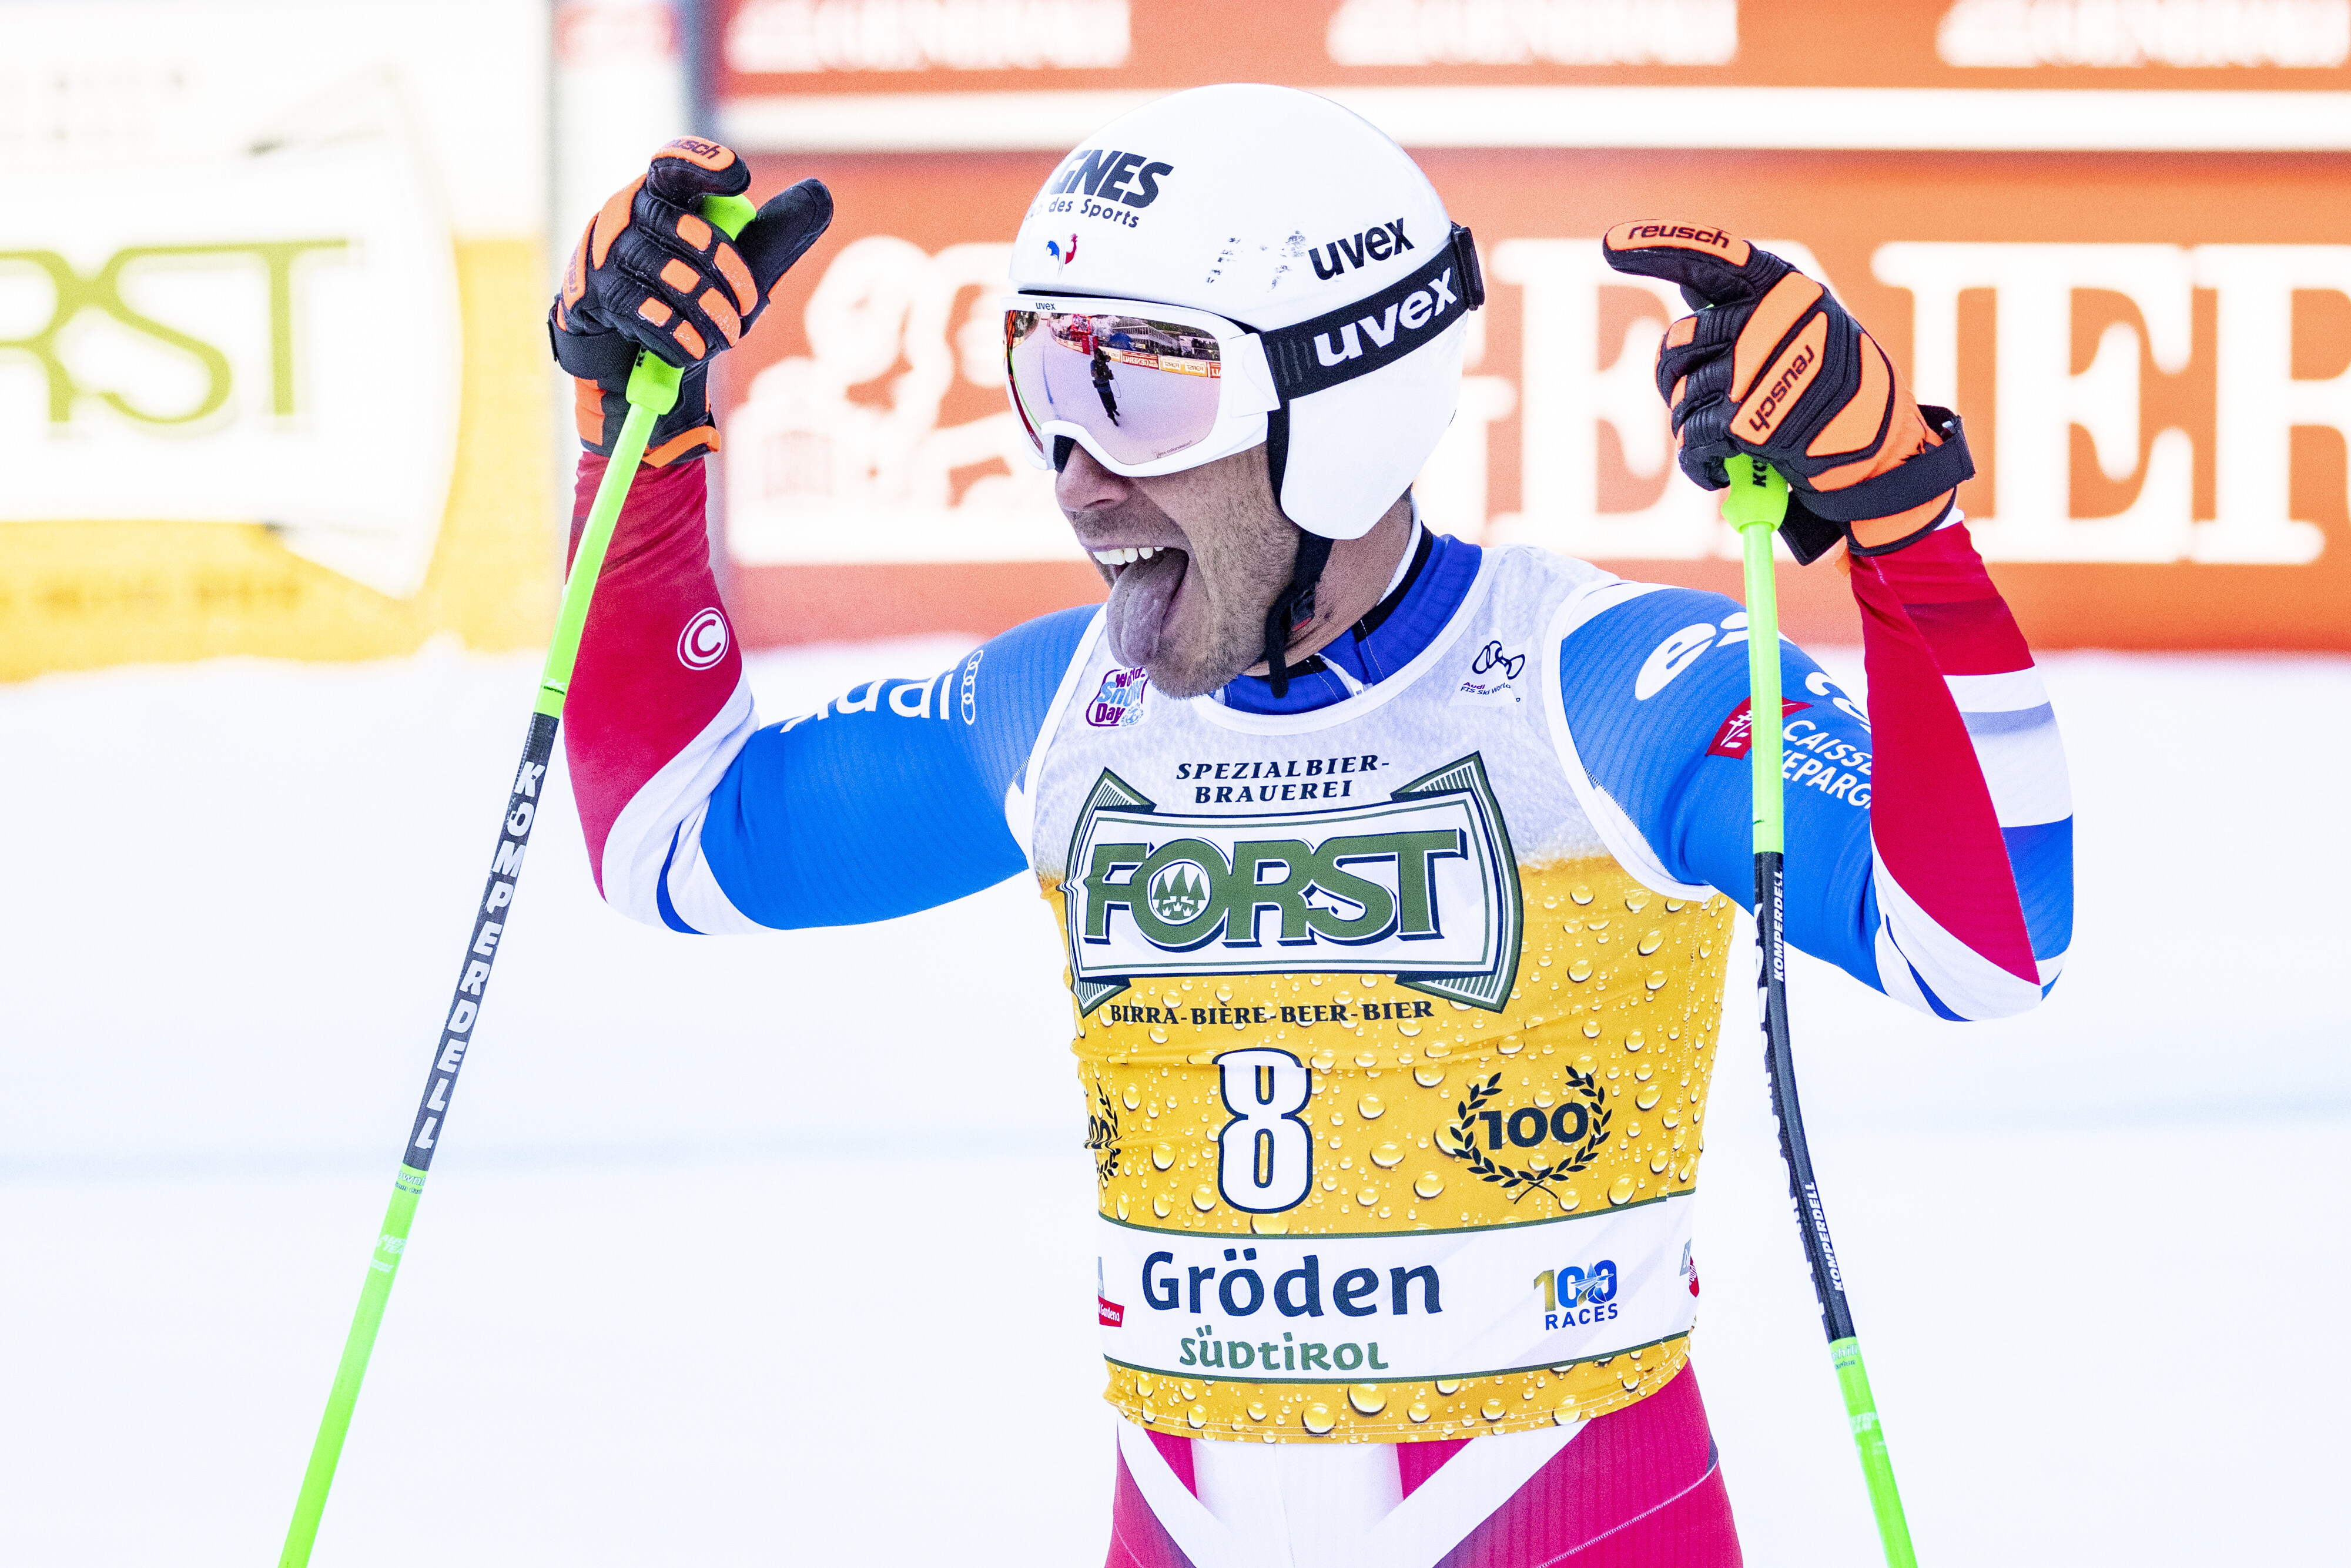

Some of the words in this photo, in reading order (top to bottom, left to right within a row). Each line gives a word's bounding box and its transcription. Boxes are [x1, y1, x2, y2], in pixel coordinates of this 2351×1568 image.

[1049, 197, 1074, 212] des
[1080, 198, 1140, 228] Sports
[1309, 218, 1415, 280] uvex
[1628, 225, 1730, 249] reusch
[1036, 302, 1057, 310] uvex
[1314, 267, 1458, 367] uvex
[1749, 344, 1815, 434] reusch
[1095, 703, 1126, 724] Day
[1097, 680, 1144, 707] Snow
[1176, 755, 1391, 780] SPEZIALBIER-
[1194, 780, 1353, 804] BRAUEREI
[1083, 827, 1468, 953] FORST
[1773, 870, 1784, 983] KOMPERDELL
[414, 760, 547, 1150] KOMPERDELL
[1212, 1047, 1312, 1214] 8
[1479, 1103, 1588, 1150] 100
[1806, 1181, 1845, 1292] KOMPERDELL
[1142, 1248, 1443, 1317] Gröden
[1100, 1304, 1120, 1322] Gardena
[1546, 1303, 1618, 1330] RACES
